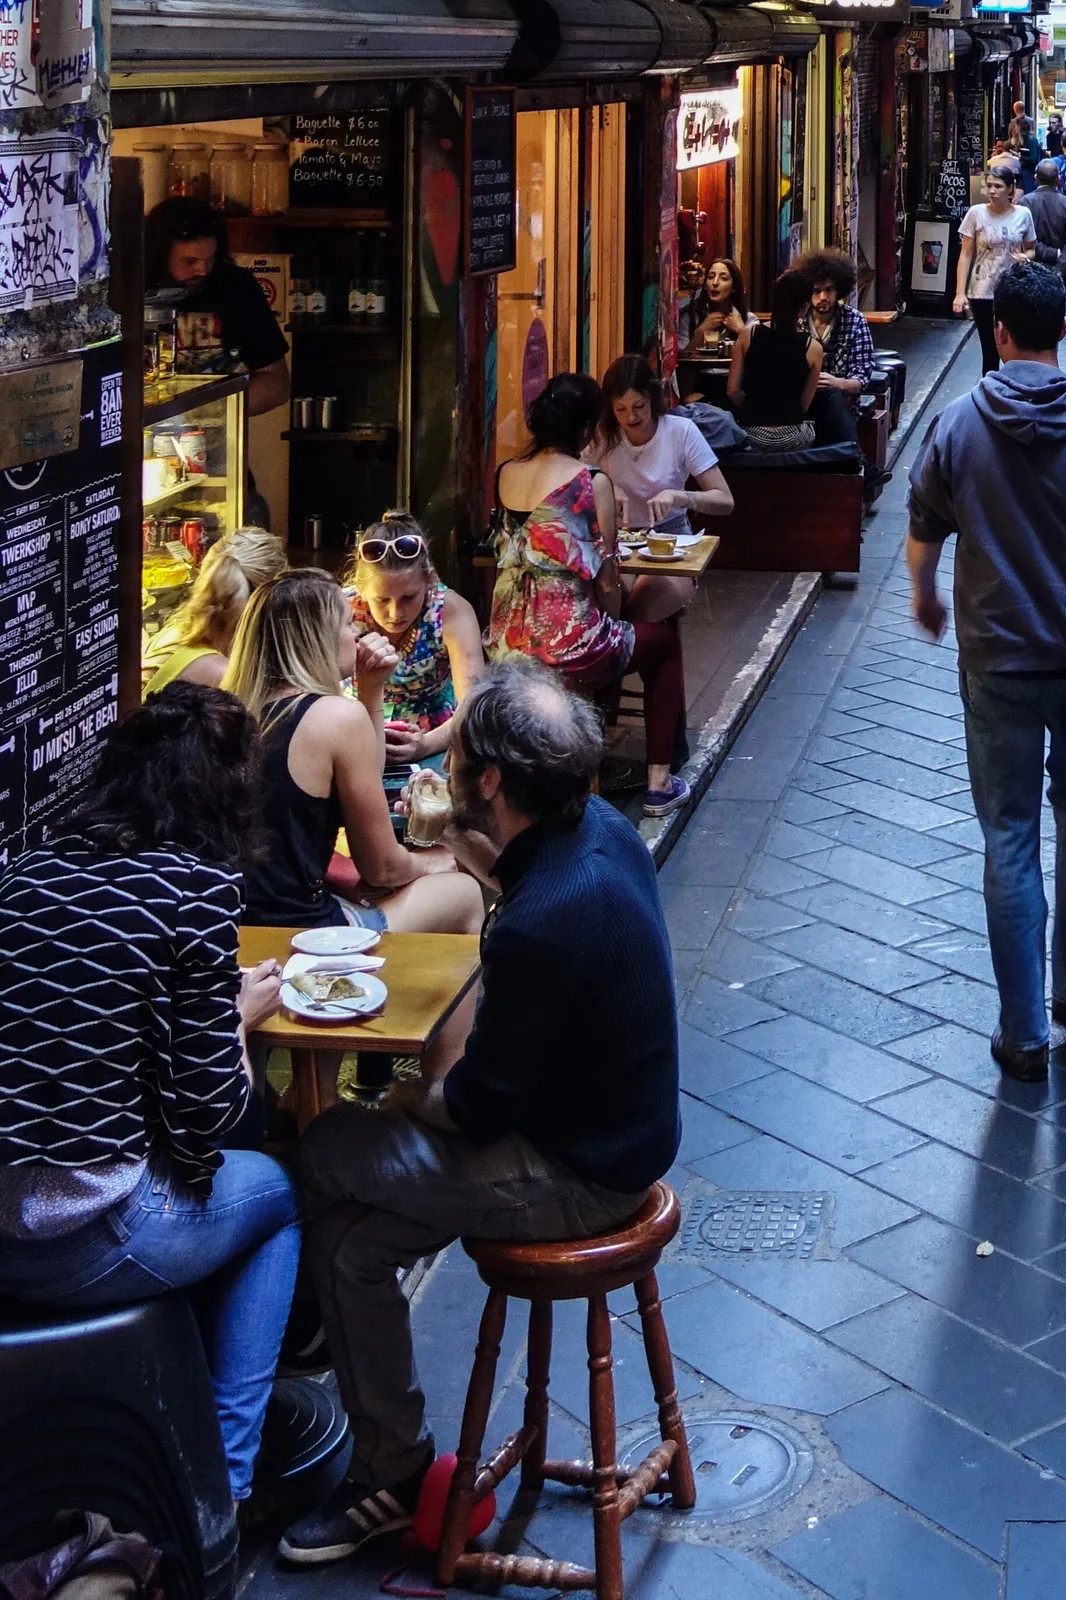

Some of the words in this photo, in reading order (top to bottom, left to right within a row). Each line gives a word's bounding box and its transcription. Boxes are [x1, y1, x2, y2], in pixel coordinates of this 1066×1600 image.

[296, 115, 341, 135] Baguette
[303, 135, 339, 147] Bacon
[345, 133, 381, 147] Lettuce
[299, 151, 336, 165] Tomato
[351, 152, 384, 171] Mayo
[942, 160, 958, 168] SOFT
[293, 168, 343, 188] Baguette
[940, 173, 965, 187] TACOS
[101, 379, 116, 392] OPEN
[85, 485, 116, 507] SATURDAY
[6, 515, 48, 541] WEDNESDAY
[91, 505, 121, 531] SATURD
[1, 532, 52, 568] TWERKSHOP
[17, 590, 37, 614] MVP
[9, 648, 43, 675] THURSDAY
[15, 669, 38, 696] JELLO
[72, 685, 105, 714] SEPTEMBER
[32, 745, 46, 773] DJ
[78, 713, 95, 742] THE
